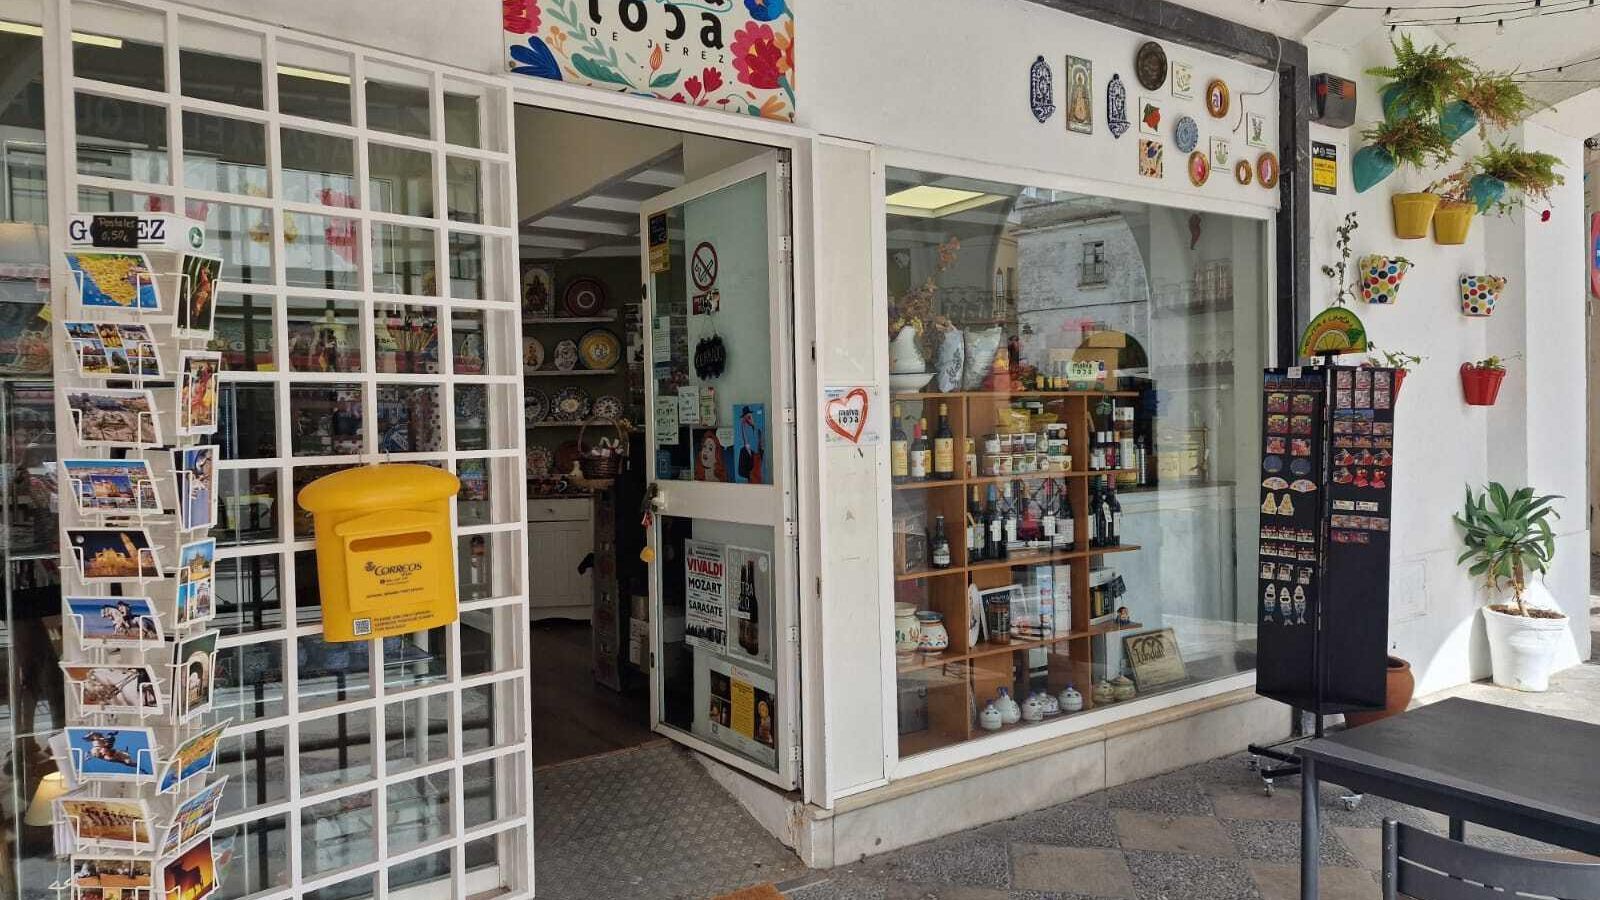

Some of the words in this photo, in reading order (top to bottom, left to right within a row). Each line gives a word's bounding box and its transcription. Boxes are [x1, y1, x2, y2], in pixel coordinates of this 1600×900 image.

[590, 27, 618, 42] DE
[648, 39, 724, 63] JEREZ
[687, 557, 723, 577] VIVALDI
[687, 577, 723, 595] MOZART
[688, 600, 723, 617] SARASATE
